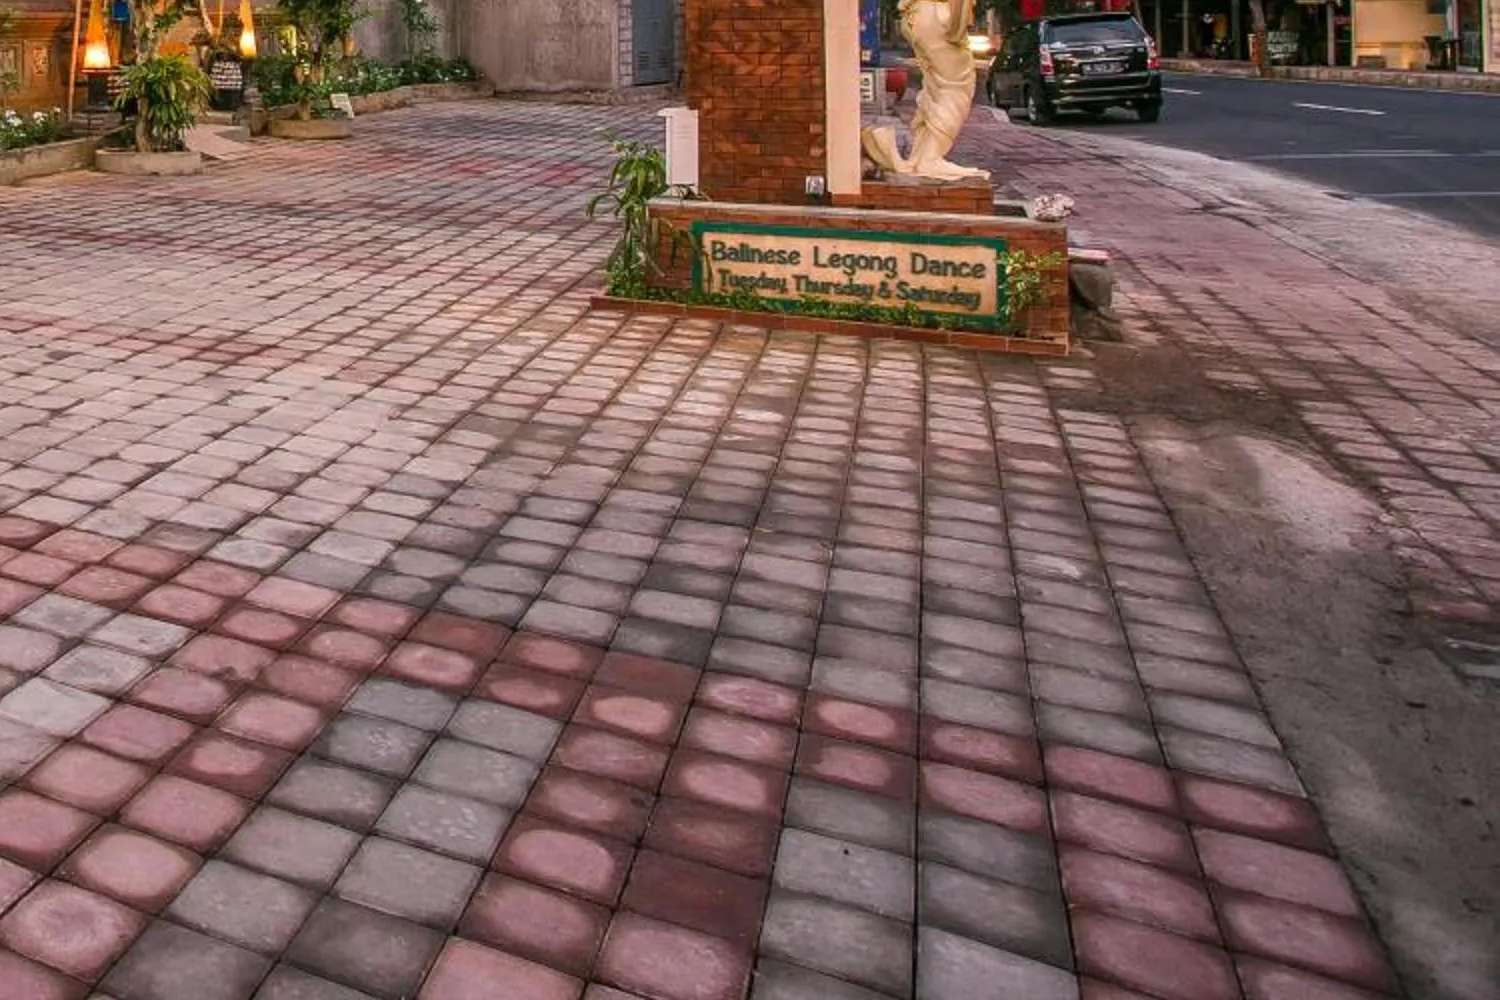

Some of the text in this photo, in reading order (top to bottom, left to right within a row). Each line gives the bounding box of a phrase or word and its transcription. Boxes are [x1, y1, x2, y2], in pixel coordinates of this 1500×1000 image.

[711, 240, 986, 279] Balinese Legong Dance
[793, 275, 874, 301] Thursday
[878, 281, 891, 299] &
[896, 281, 981, 311] Saturday
